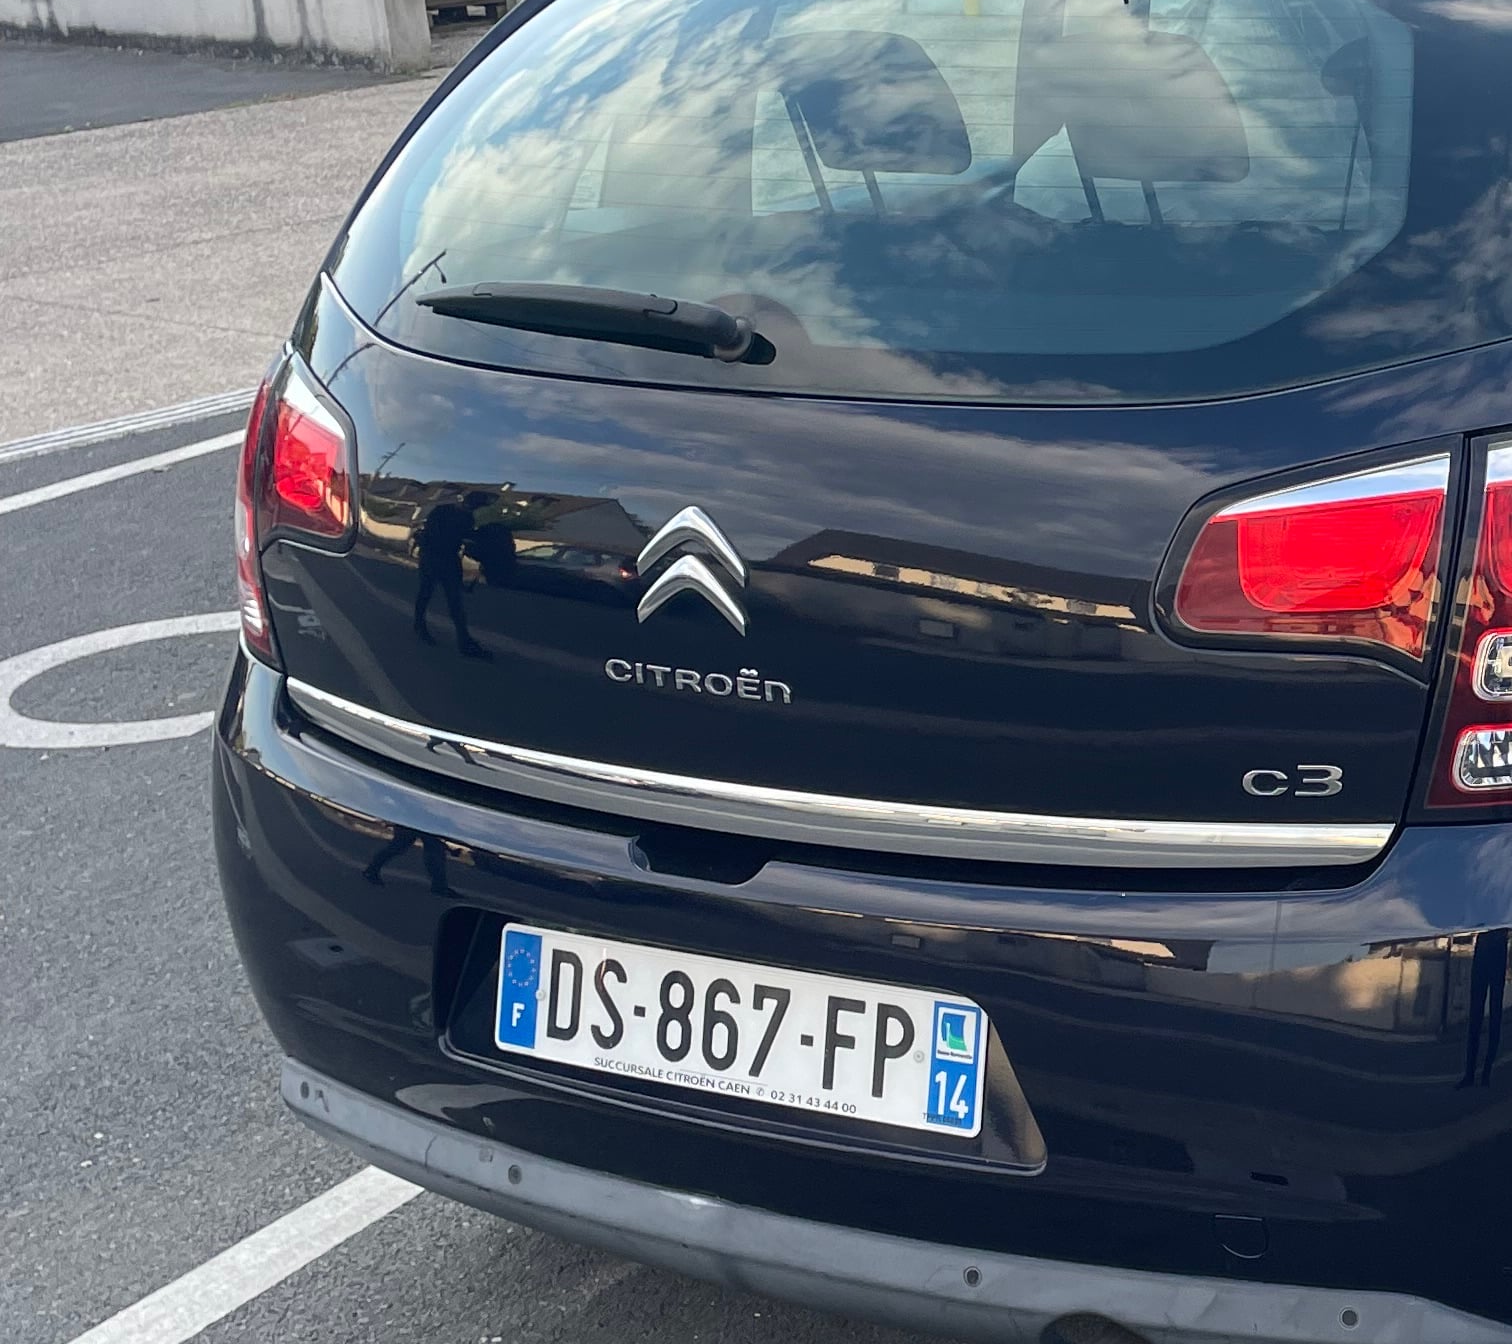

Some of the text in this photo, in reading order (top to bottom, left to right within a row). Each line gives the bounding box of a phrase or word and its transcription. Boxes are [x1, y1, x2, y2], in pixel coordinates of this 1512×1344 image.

[1242, 764, 1343, 796] C3
[510, 1002, 526, 1028] F
[546, 949, 916, 1099] DS-867-FP
[594, 1056, 664, 1079] SUCCURSALE
[718, 1080, 751, 1095] CAEN
[770, 1090, 785, 1102] 02
[788, 1093, 802, 1104] 31
[806, 1096, 821, 1108] 43
[824, 1099, 839, 1111] 44
[841, 1103, 857, 1114] 00
[935, 1071, 969, 1120] 14
